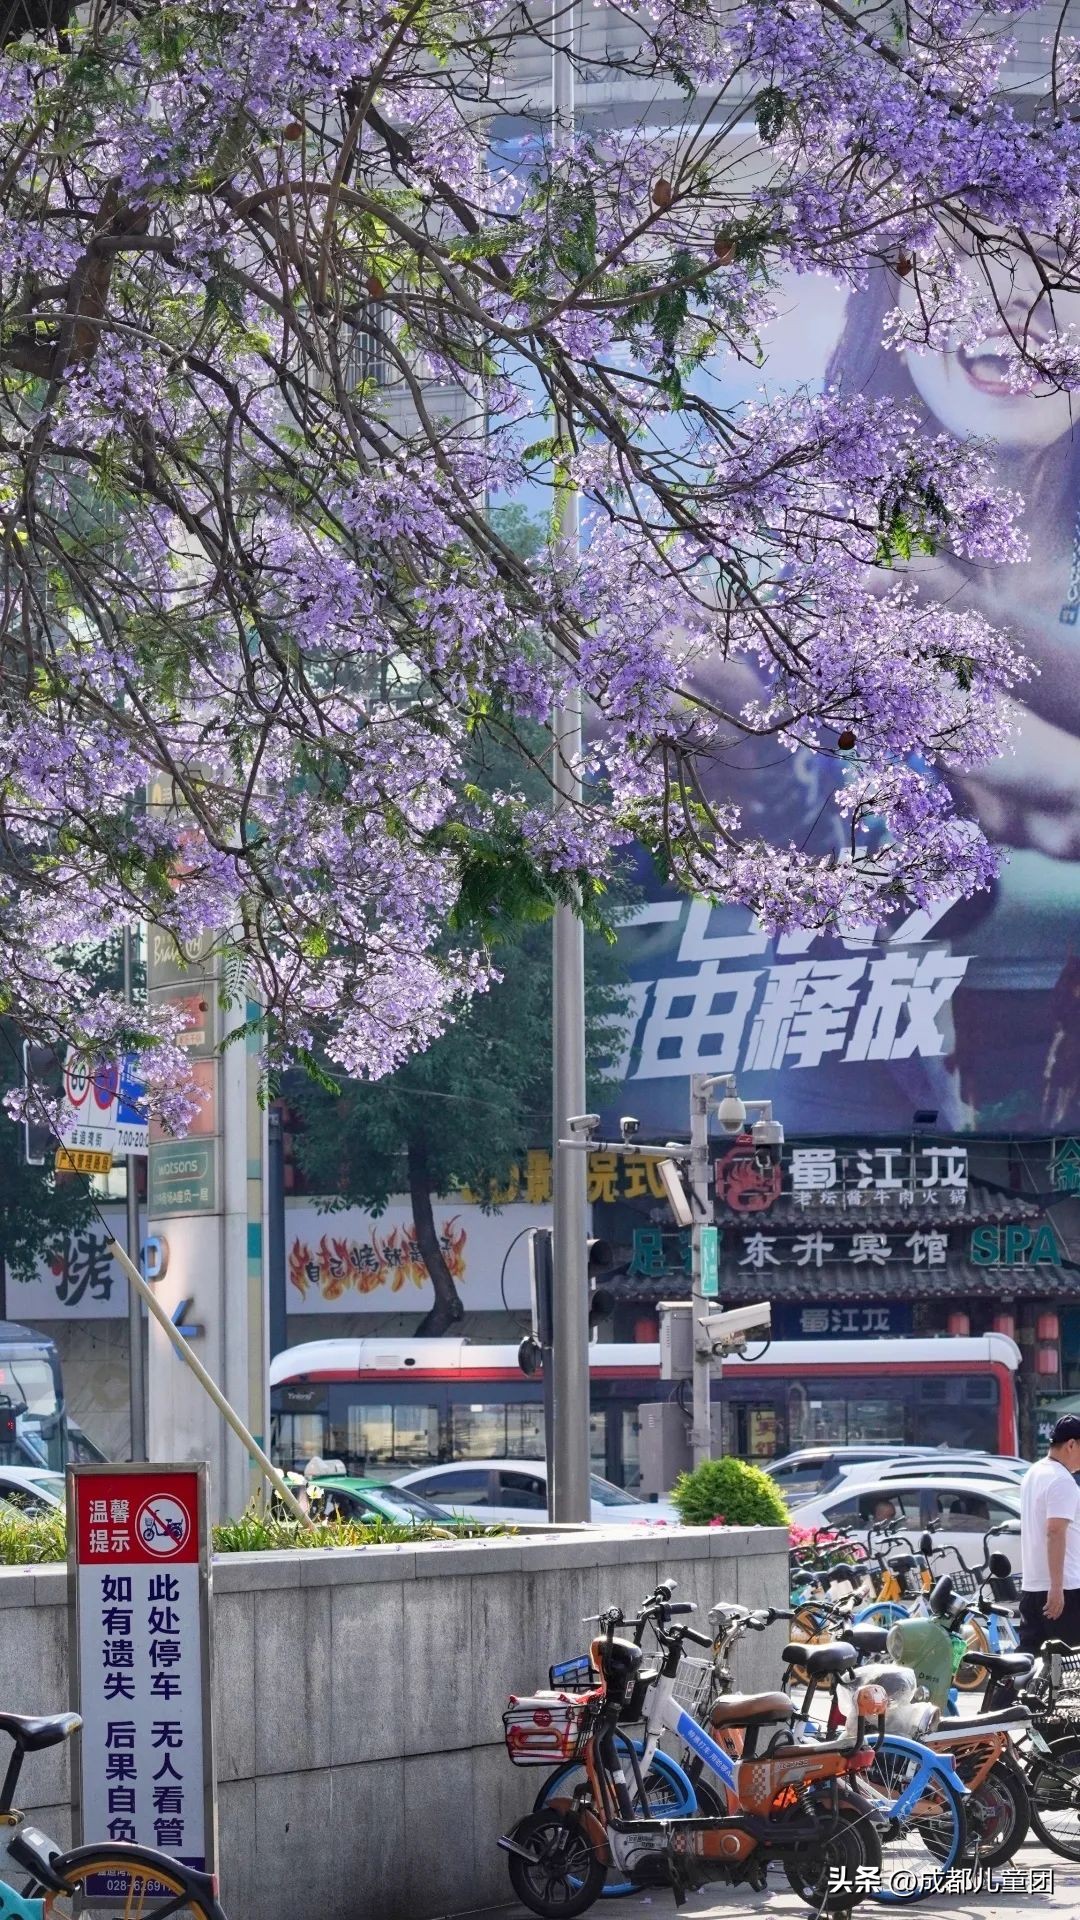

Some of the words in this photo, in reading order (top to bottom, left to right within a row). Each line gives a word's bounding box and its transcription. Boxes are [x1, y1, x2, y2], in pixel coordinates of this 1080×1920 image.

[158, 1159, 198, 1176] watsons
[52, 1231, 114, 1306] 烤
[739, 1229, 948, 1267] 东升宾馆
[970, 1224, 1062, 1266] SPA
[89, 1499, 130, 1524] 温馨
[89, 1530, 130, 1553] 提示
[101, 1574, 136, 1701] 如有遗失
[148, 1574, 182, 1701] 此处停车
[105, 1720, 138, 1846] 后果自负
[151, 1720, 185, 1848] 无人看管
